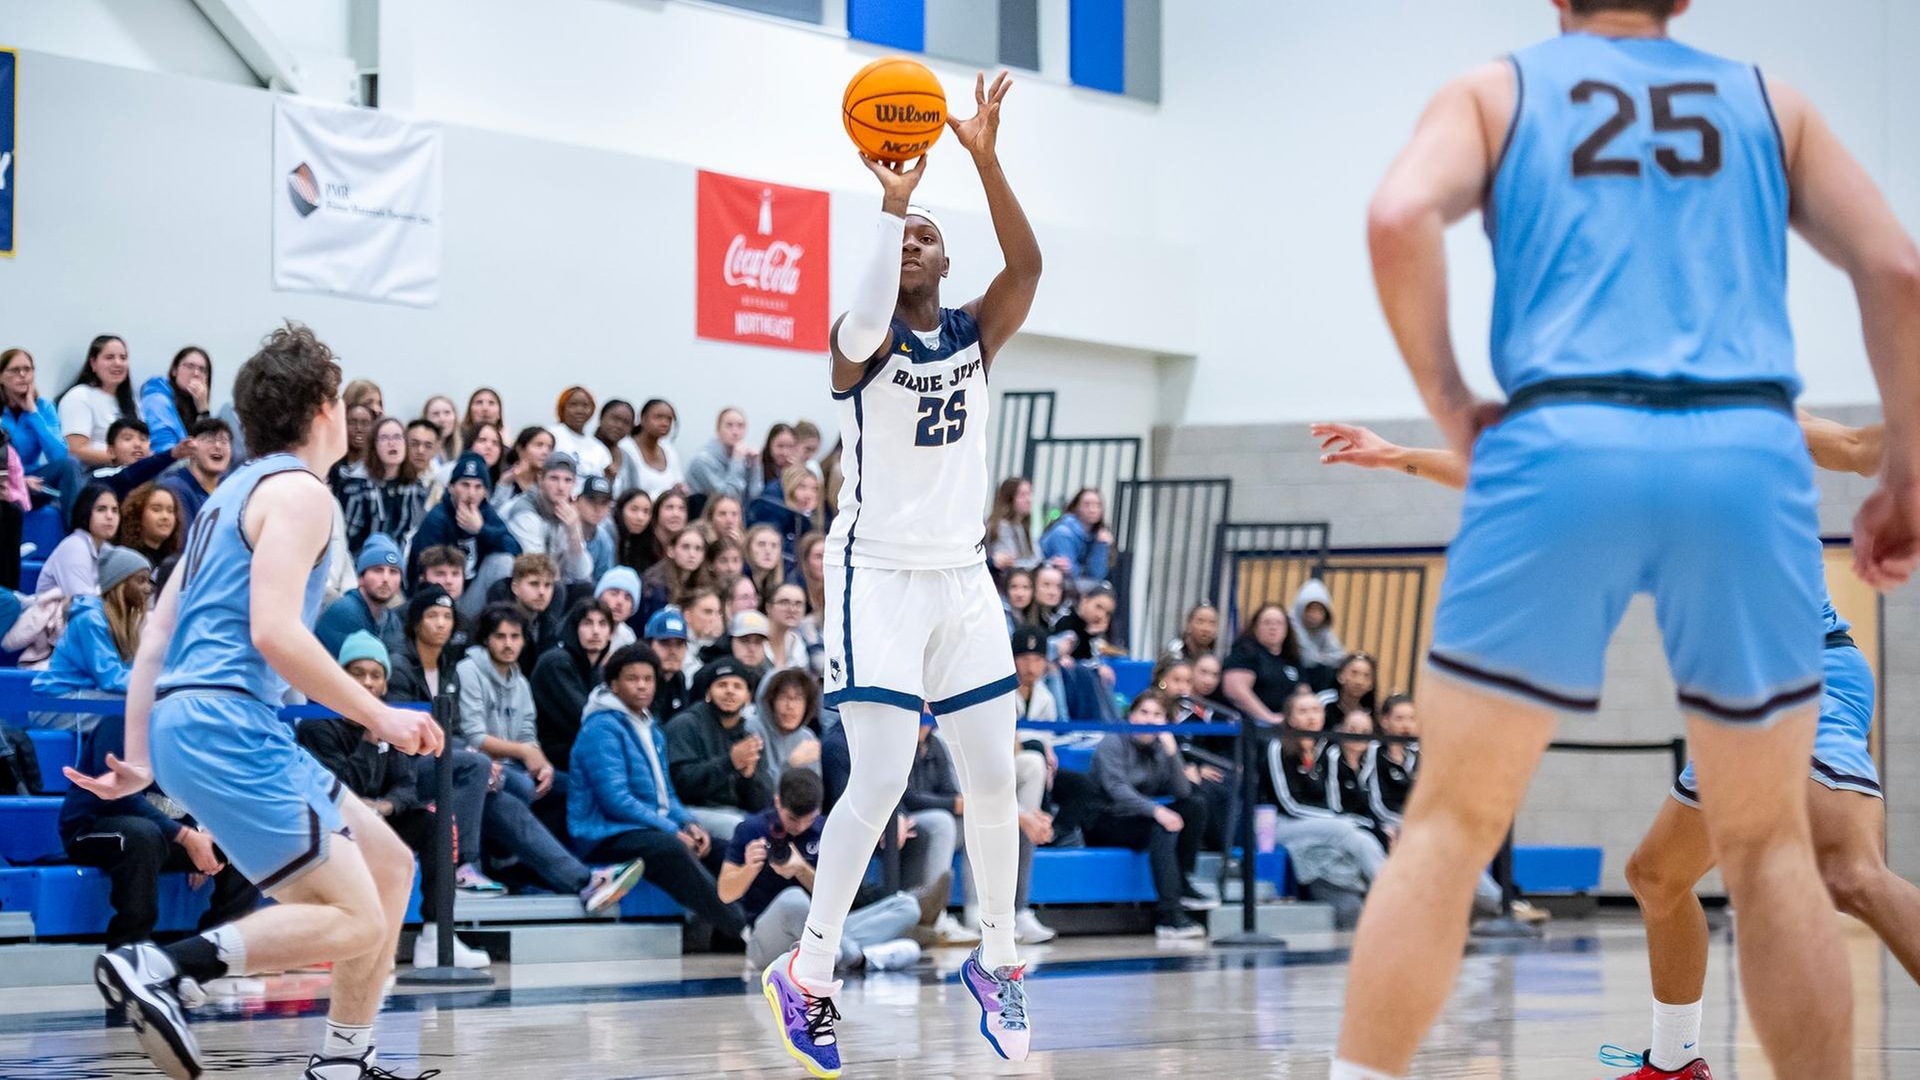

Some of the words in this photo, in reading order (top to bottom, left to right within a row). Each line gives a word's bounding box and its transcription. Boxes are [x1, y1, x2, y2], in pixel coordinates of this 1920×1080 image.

[875, 104, 940, 123] Wilson
[1569, 79, 1723, 178] 25
[735, 311, 795, 341] NORTHEAST
[892, 369, 943, 393] BLUE
[914, 389, 967, 446] 25
